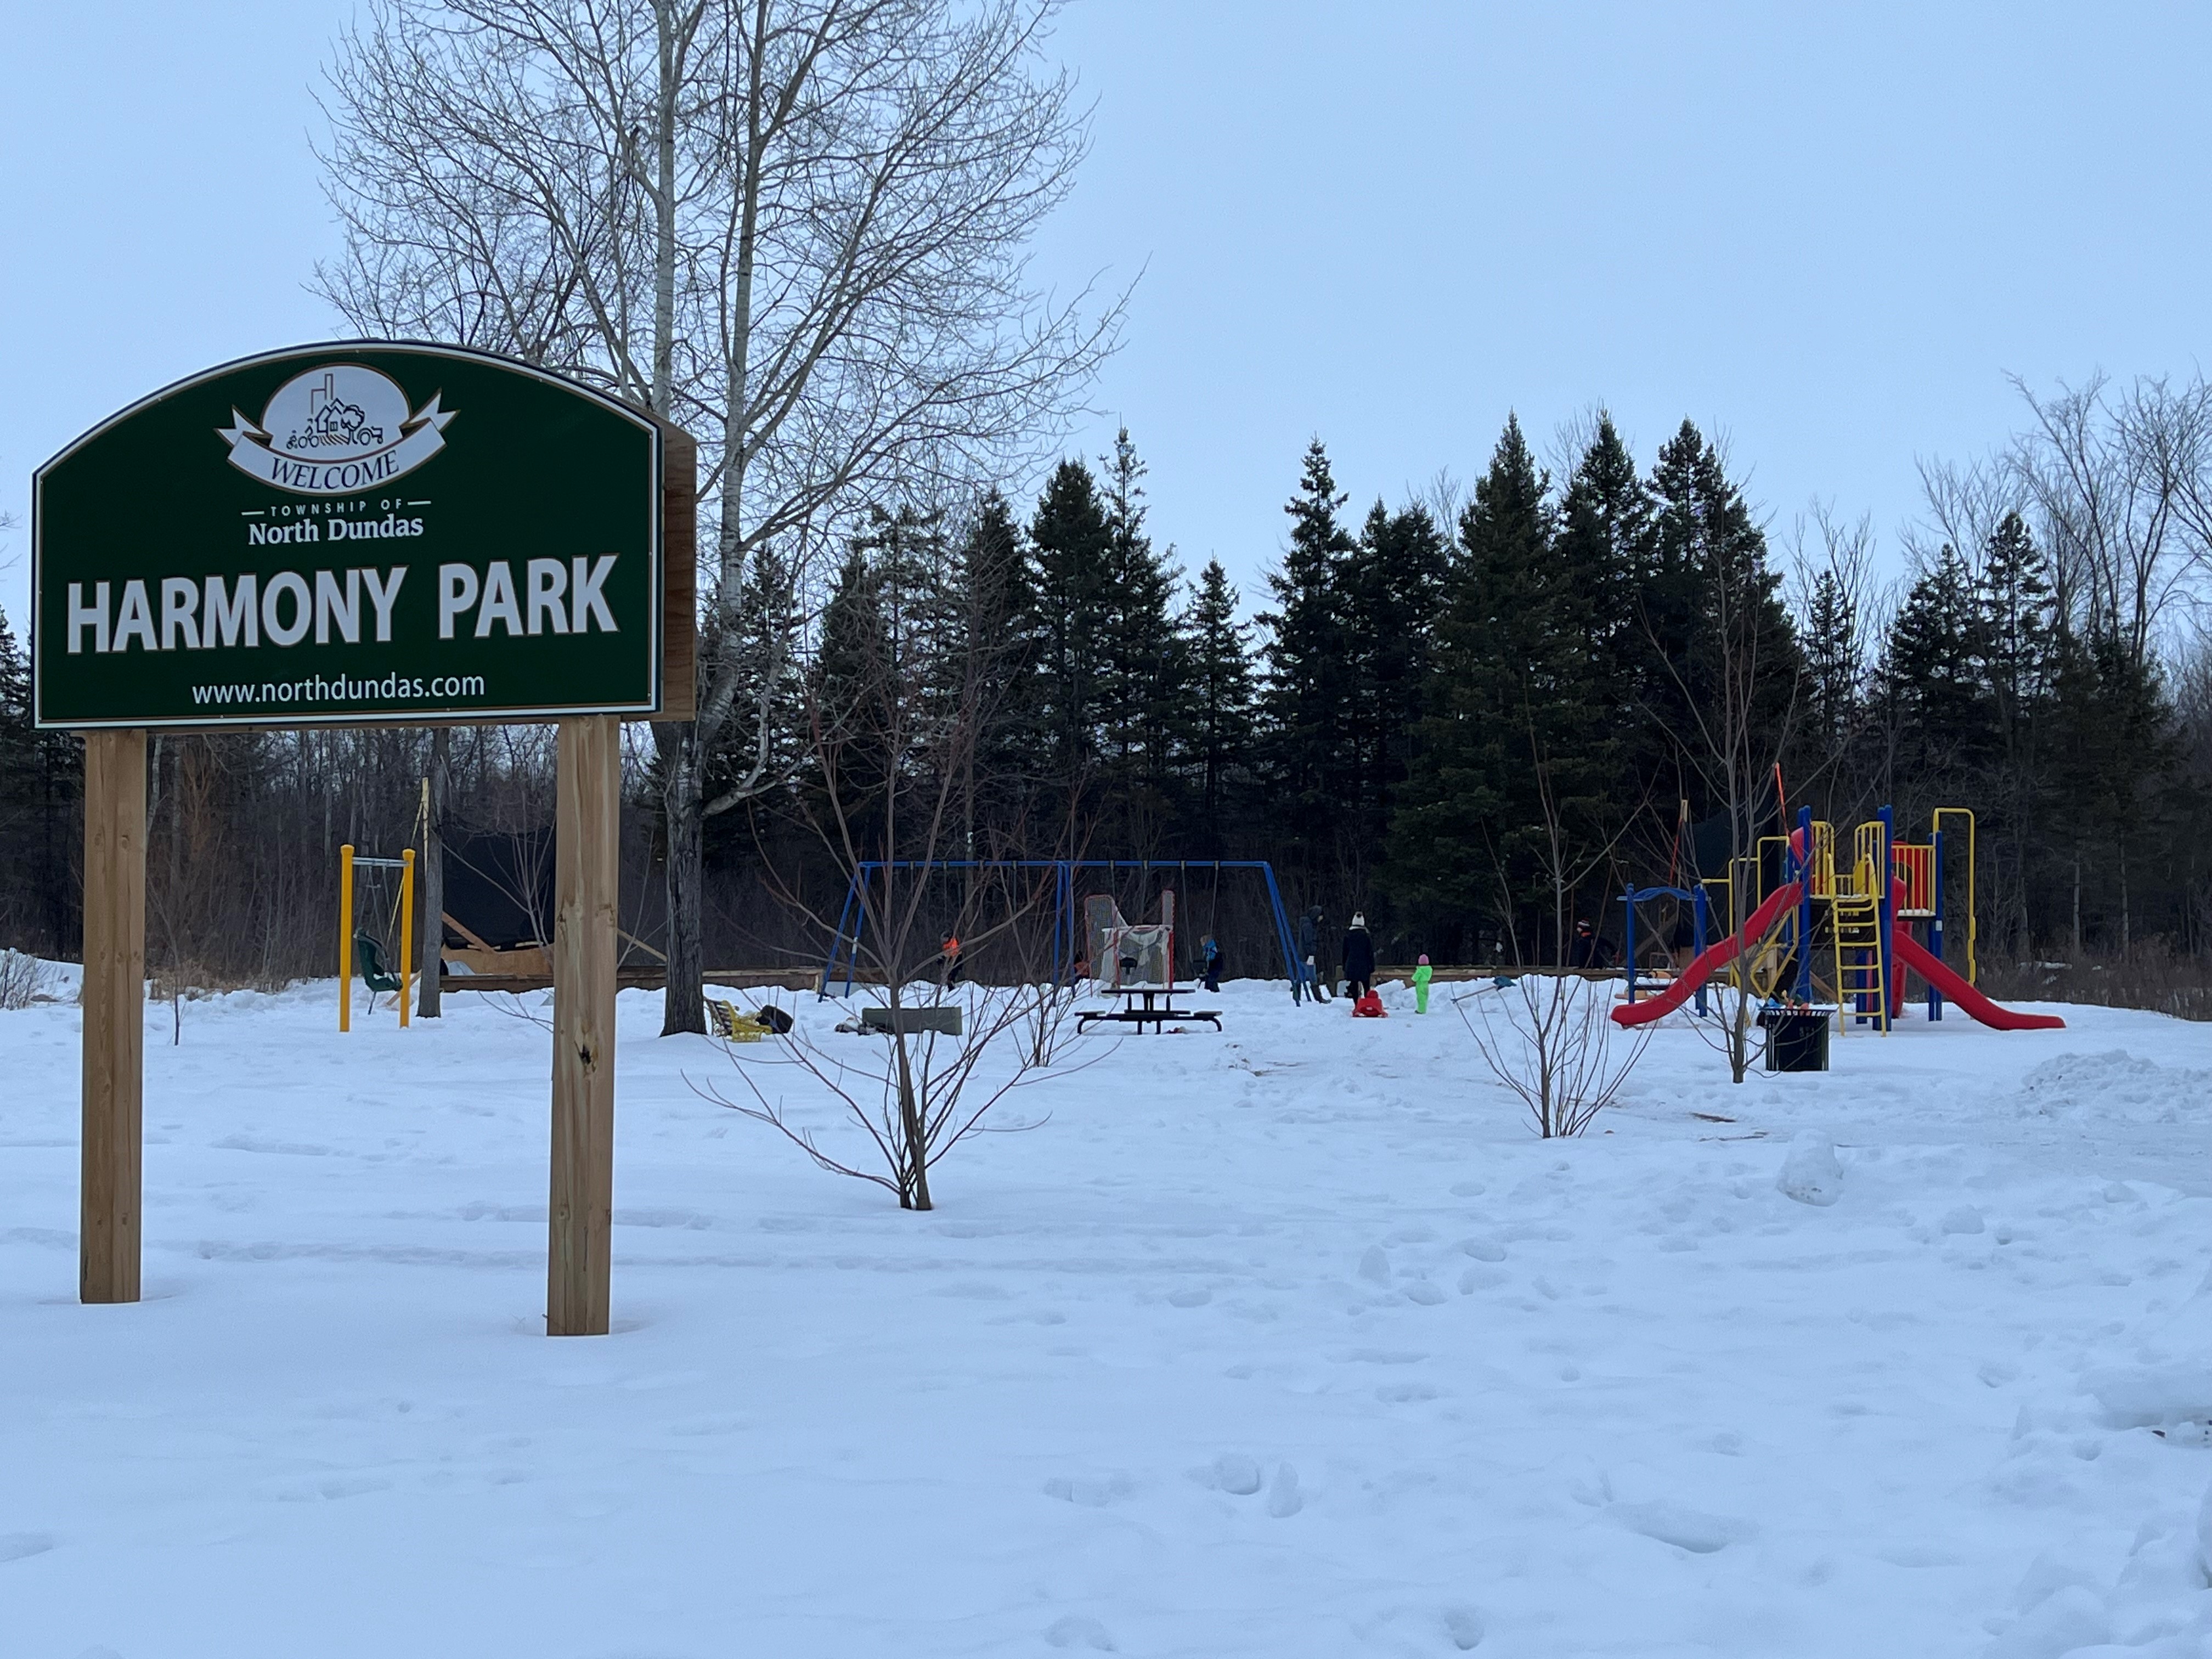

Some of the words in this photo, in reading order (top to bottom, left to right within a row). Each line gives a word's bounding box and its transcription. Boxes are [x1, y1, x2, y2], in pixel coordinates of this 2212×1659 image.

[271, 449, 399, 489] WELCOME
[270, 501, 366, 517] TOWNSHIP
[381, 499, 402, 510] OF
[249, 518, 319, 545] North
[328, 514, 424, 541] Dundas
[68, 567, 408, 653] HARMONY
[439, 555, 618, 639] PARK
[193, 672, 484, 704] www.northdundas.com
